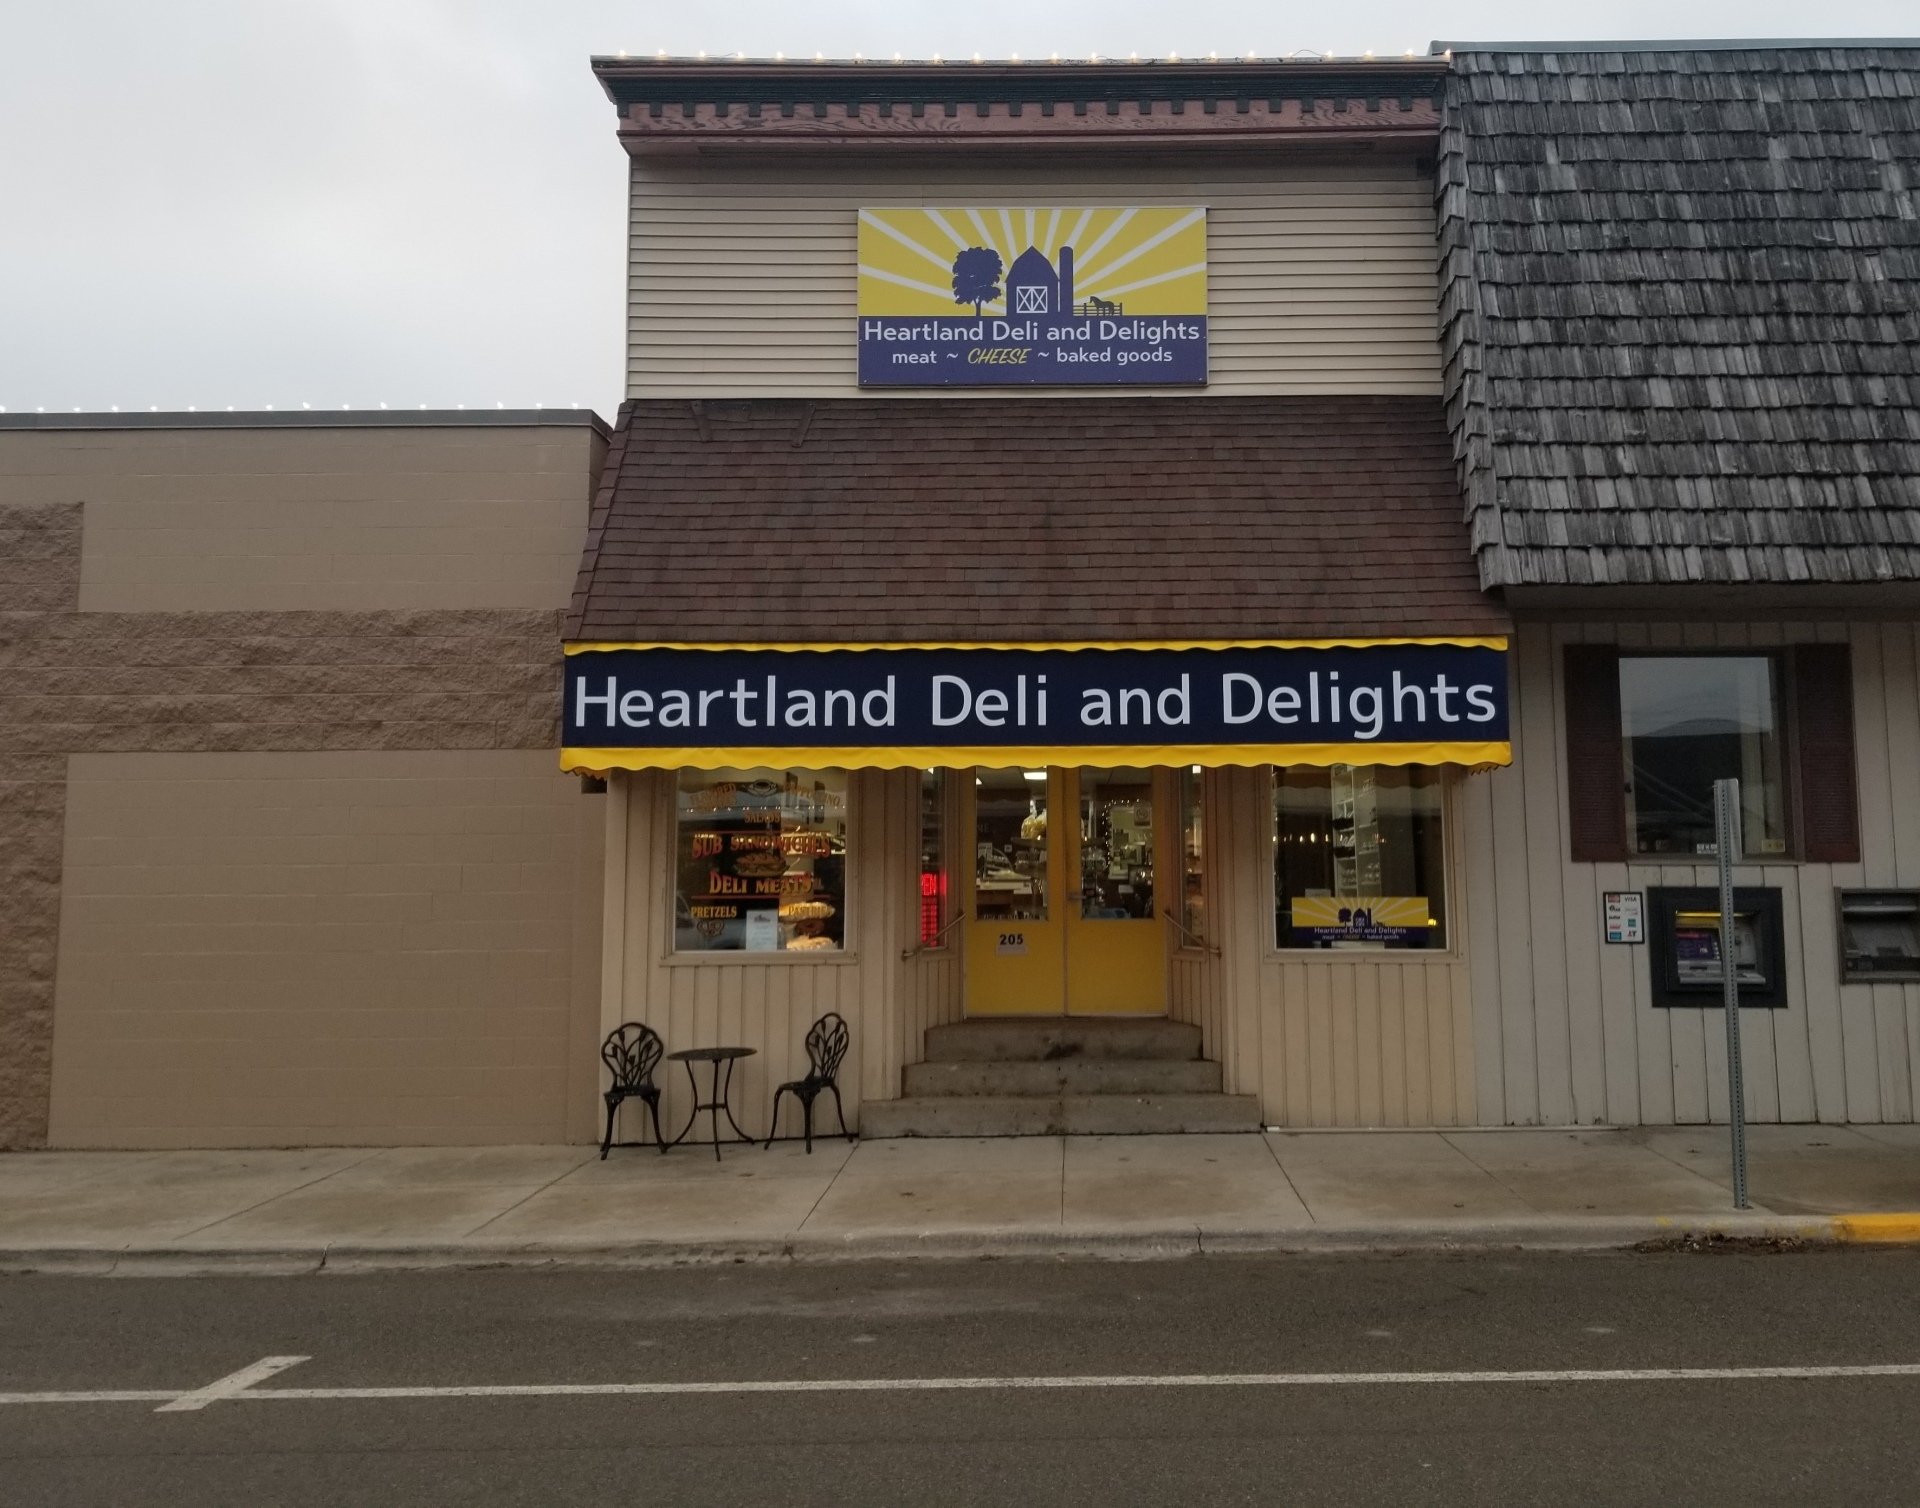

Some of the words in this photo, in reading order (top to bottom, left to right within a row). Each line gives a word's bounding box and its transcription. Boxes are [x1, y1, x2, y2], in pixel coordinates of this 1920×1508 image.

[864, 320, 983, 341] Heartland
[992, 321, 1038, 341] Deli
[1046, 321, 1091, 341] and
[1099, 320, 1200, 345] Delights
[892, 350, 937, 364] meat
[967, 348, 1032, 364] CHEESE
[1056, 347, 1111, 363] baked
[1116, 347, 1173, 366] goods
[575, 675, 896, 728] Heartland
[932, 674, 1047, 727] Deli
[1080, 673, 1191, 726] and
[1222, 670, 1496, 740] Delights
[692, 835, 722, 859] SUB
[730, 834, 831, 858] SANDWICHES
[709, 870, 748, 894] DELI
[755, 872, 813, 894] MEATS
[691, 905, 737, 918] PRETZELS
[999, 934, 1024, 945] 205
[1314, 926, 1348, 934] Heartland
[1349, 926, 1363, 934] Deli
[1364, 926, 1377, 934] and
[1378, 926, 1407, 935] Delights
